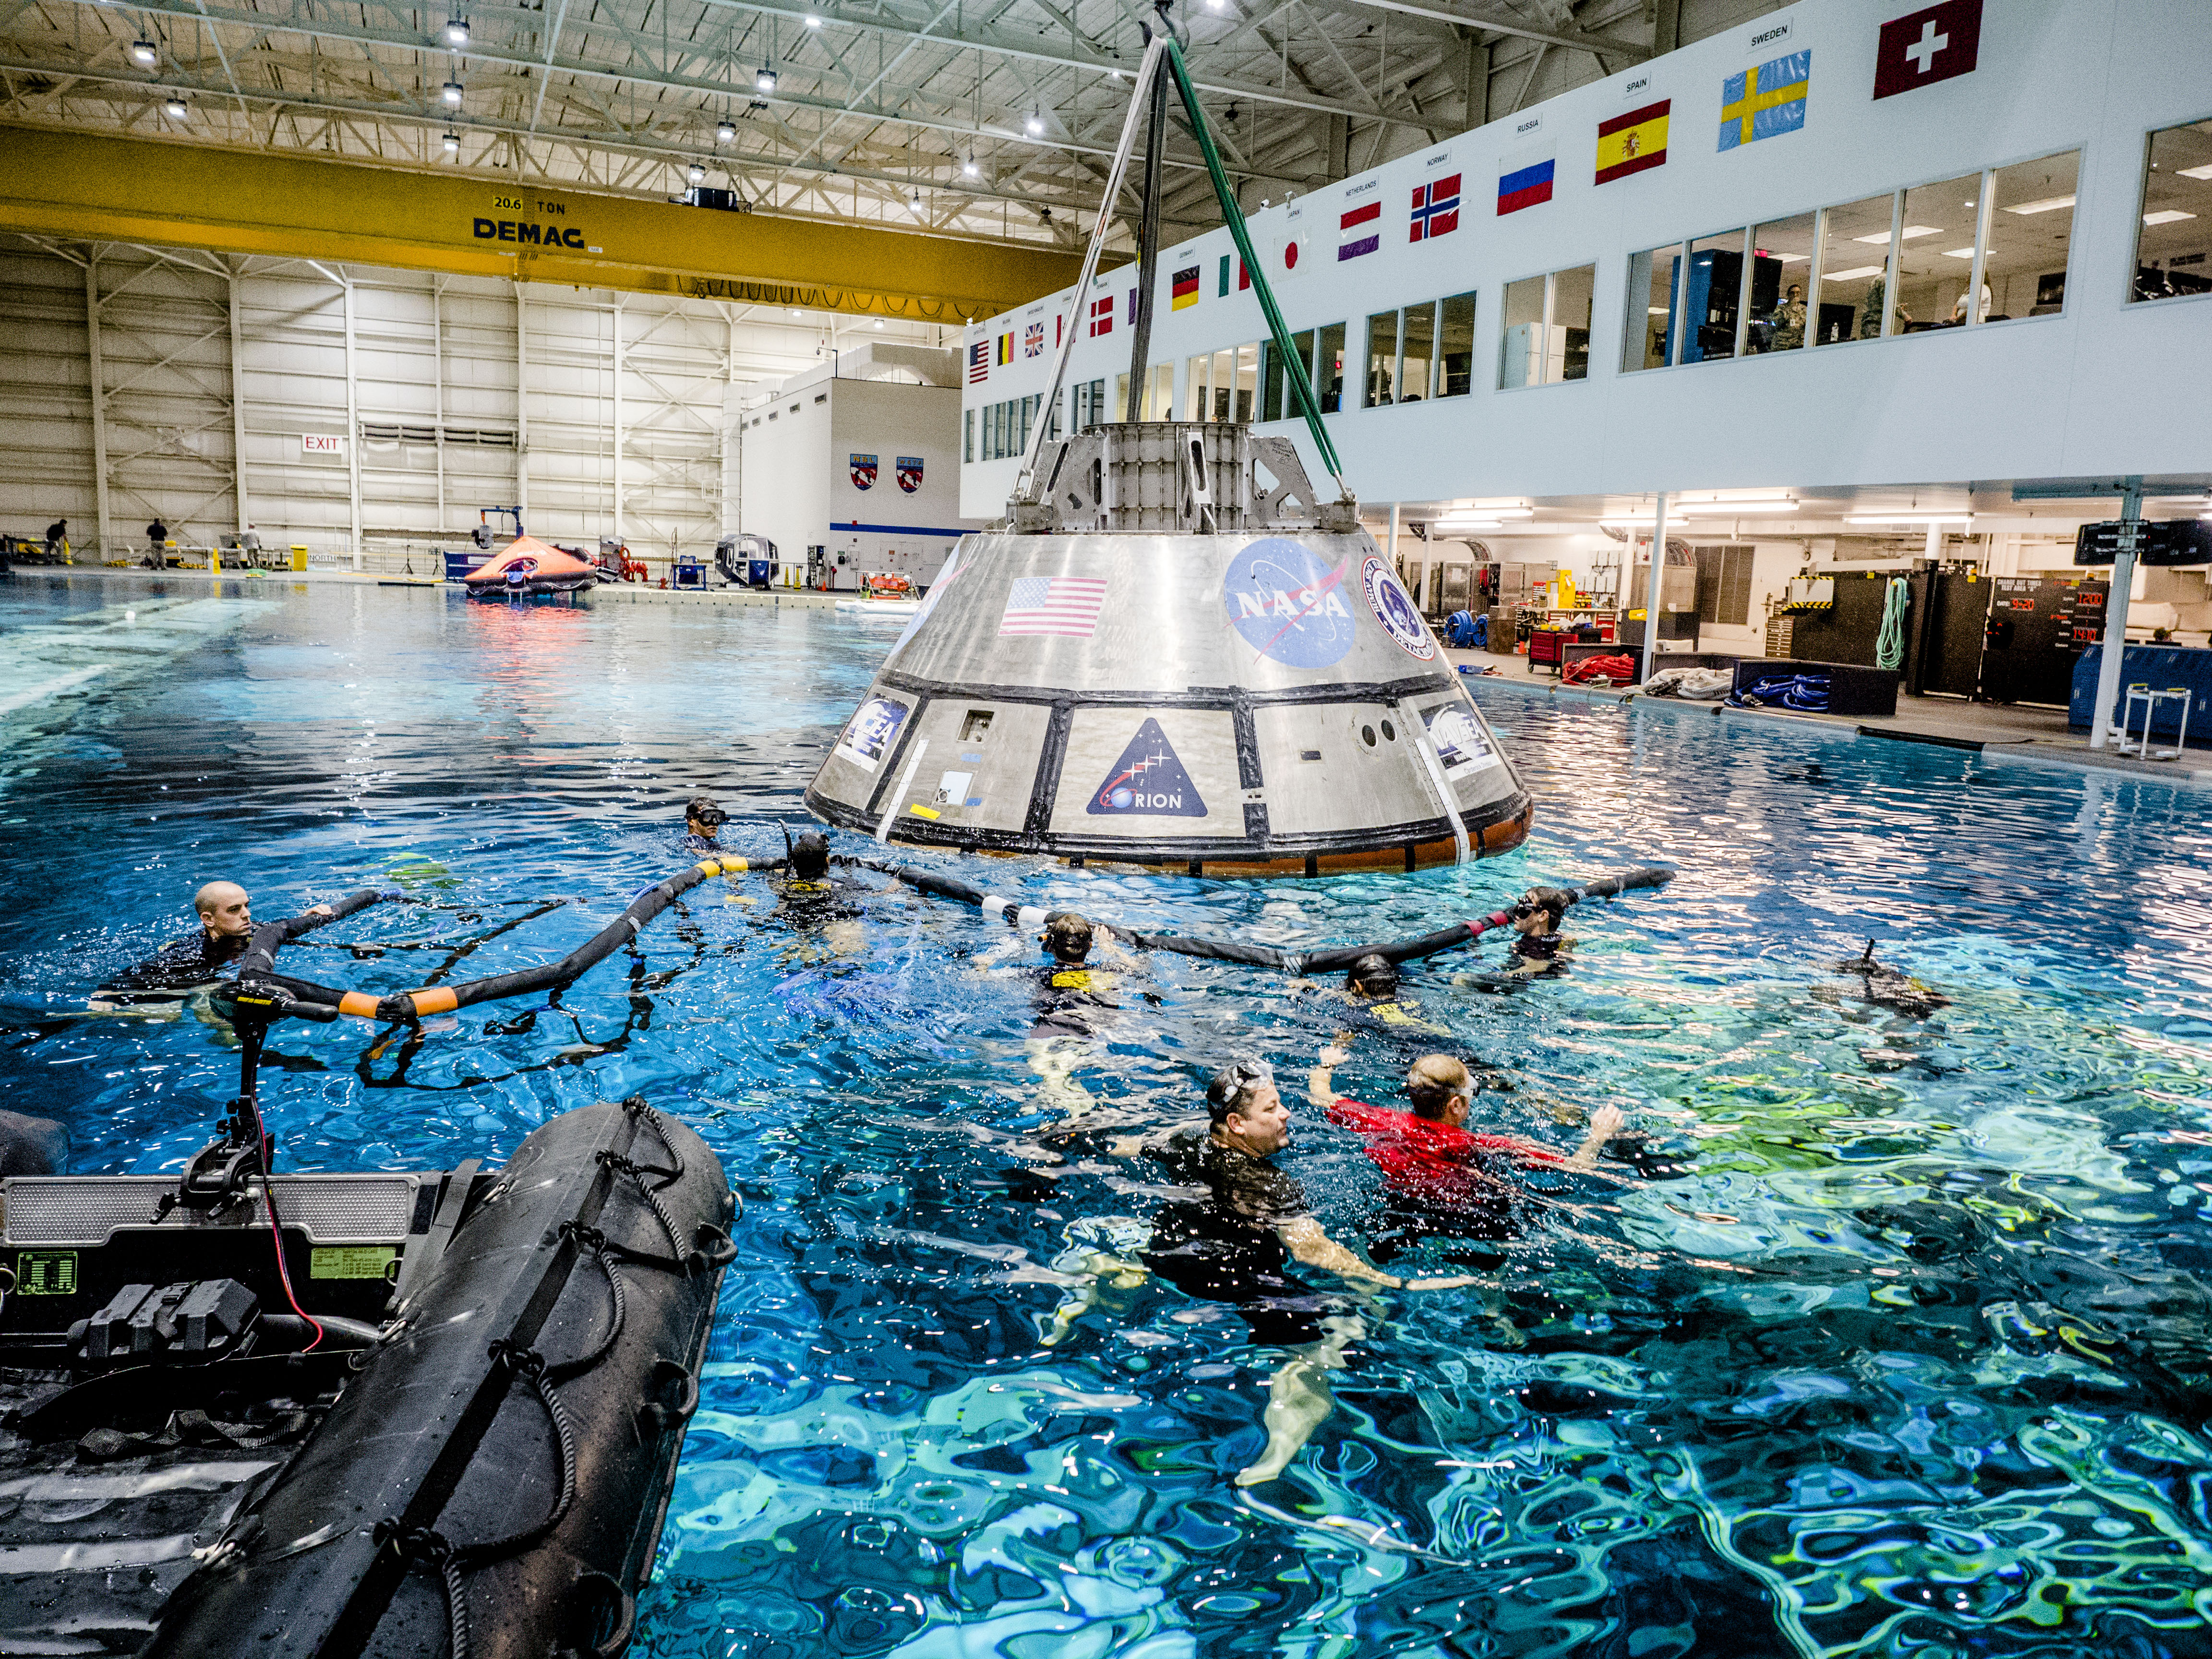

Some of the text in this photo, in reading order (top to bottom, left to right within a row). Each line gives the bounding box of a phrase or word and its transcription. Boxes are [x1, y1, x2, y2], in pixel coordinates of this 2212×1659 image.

[1751, 24, 1788, 46] SWEDEN
[1626, 78, 1647, 92] SPAIN
[1517, 119, 1539, 133] RUSSIA
[1427, 153, 1449, 167] NORWAY
[1345, 180, 1377, 197] NETHERLANDS
[494, 197, 565, 215] 20.6 TON
[1288, 208, 1300, 218] JAPAN
[473, 217, 585, 249] DEMAG
[1179, 249, 1193, 258] GERMANY
[306, 436, 339, 449] EXIT
[1234, 590, 1350, 619] NASA
[2012, 599, 2035, 610] 9-20
[1427, 718, 1485, 751] NAVSEA
